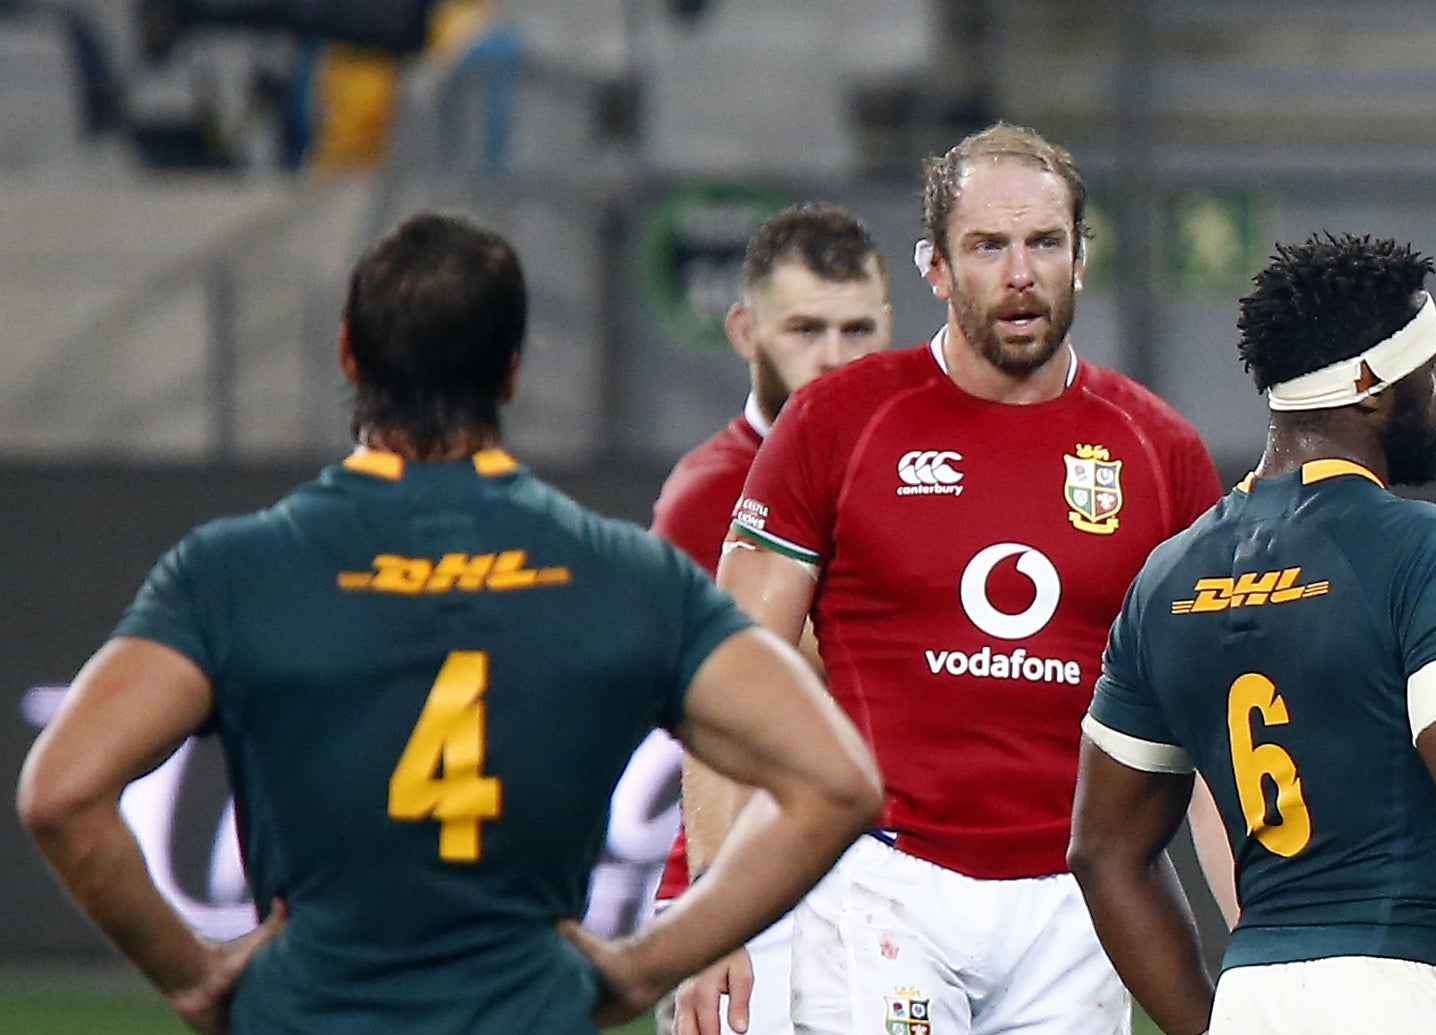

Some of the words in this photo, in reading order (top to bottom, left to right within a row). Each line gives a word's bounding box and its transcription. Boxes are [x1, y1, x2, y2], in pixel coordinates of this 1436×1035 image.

[897, 483, 963, 496] canterbury
[371, 550, 538, 593] DHL
[1191, 567, 1305, 613] DHL
[925, 646, 1081, 685] vodafone
[387, 649, 502, 862] 4
[1227, 672, 1311, 858] 6
